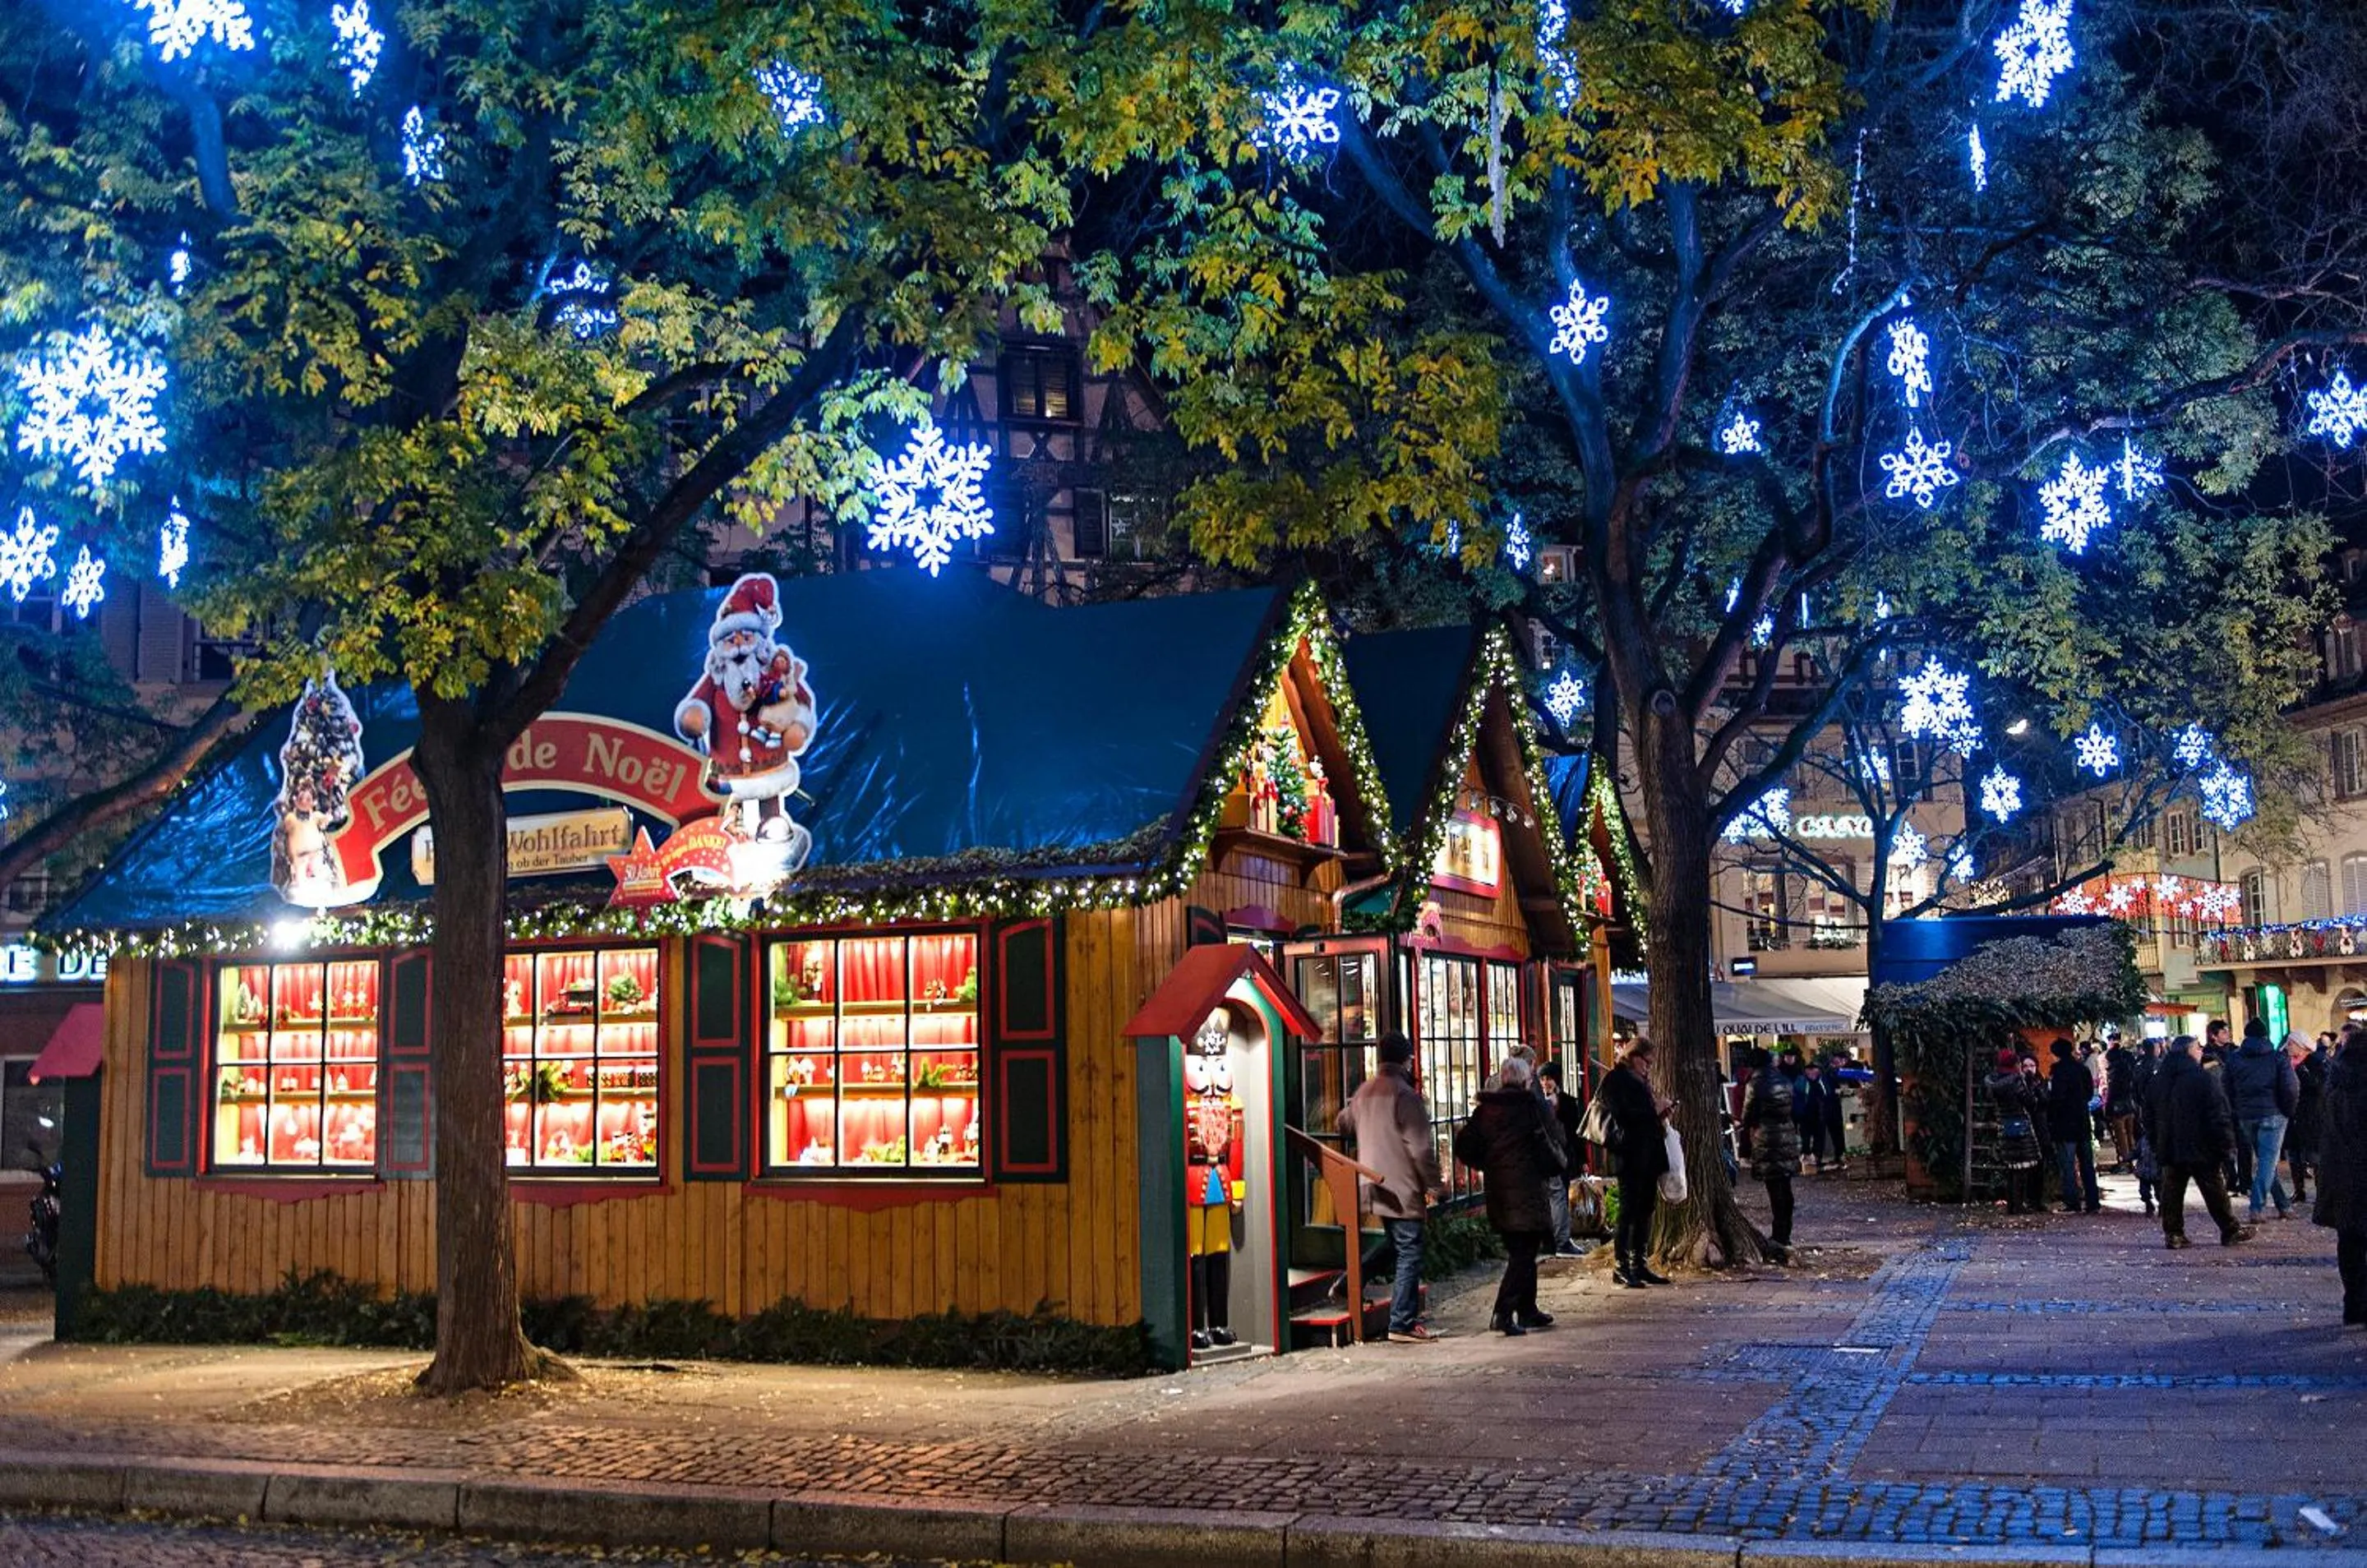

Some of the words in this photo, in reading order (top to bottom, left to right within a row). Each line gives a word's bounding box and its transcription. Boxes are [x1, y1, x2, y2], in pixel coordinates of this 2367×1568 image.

[507, 728, 558, 771] de
[582, 731, 688, 804] Noël
[507, 823, 621, 853] Wohlfahrt
[516, 856, 531, 869] ob
[532, 853, 550, 868] der
[554, 852, 589, 865] Tauber
[1723, 1023, 1752, 1034] QUAI
[1755, 1023, 1771, 1034] DE
